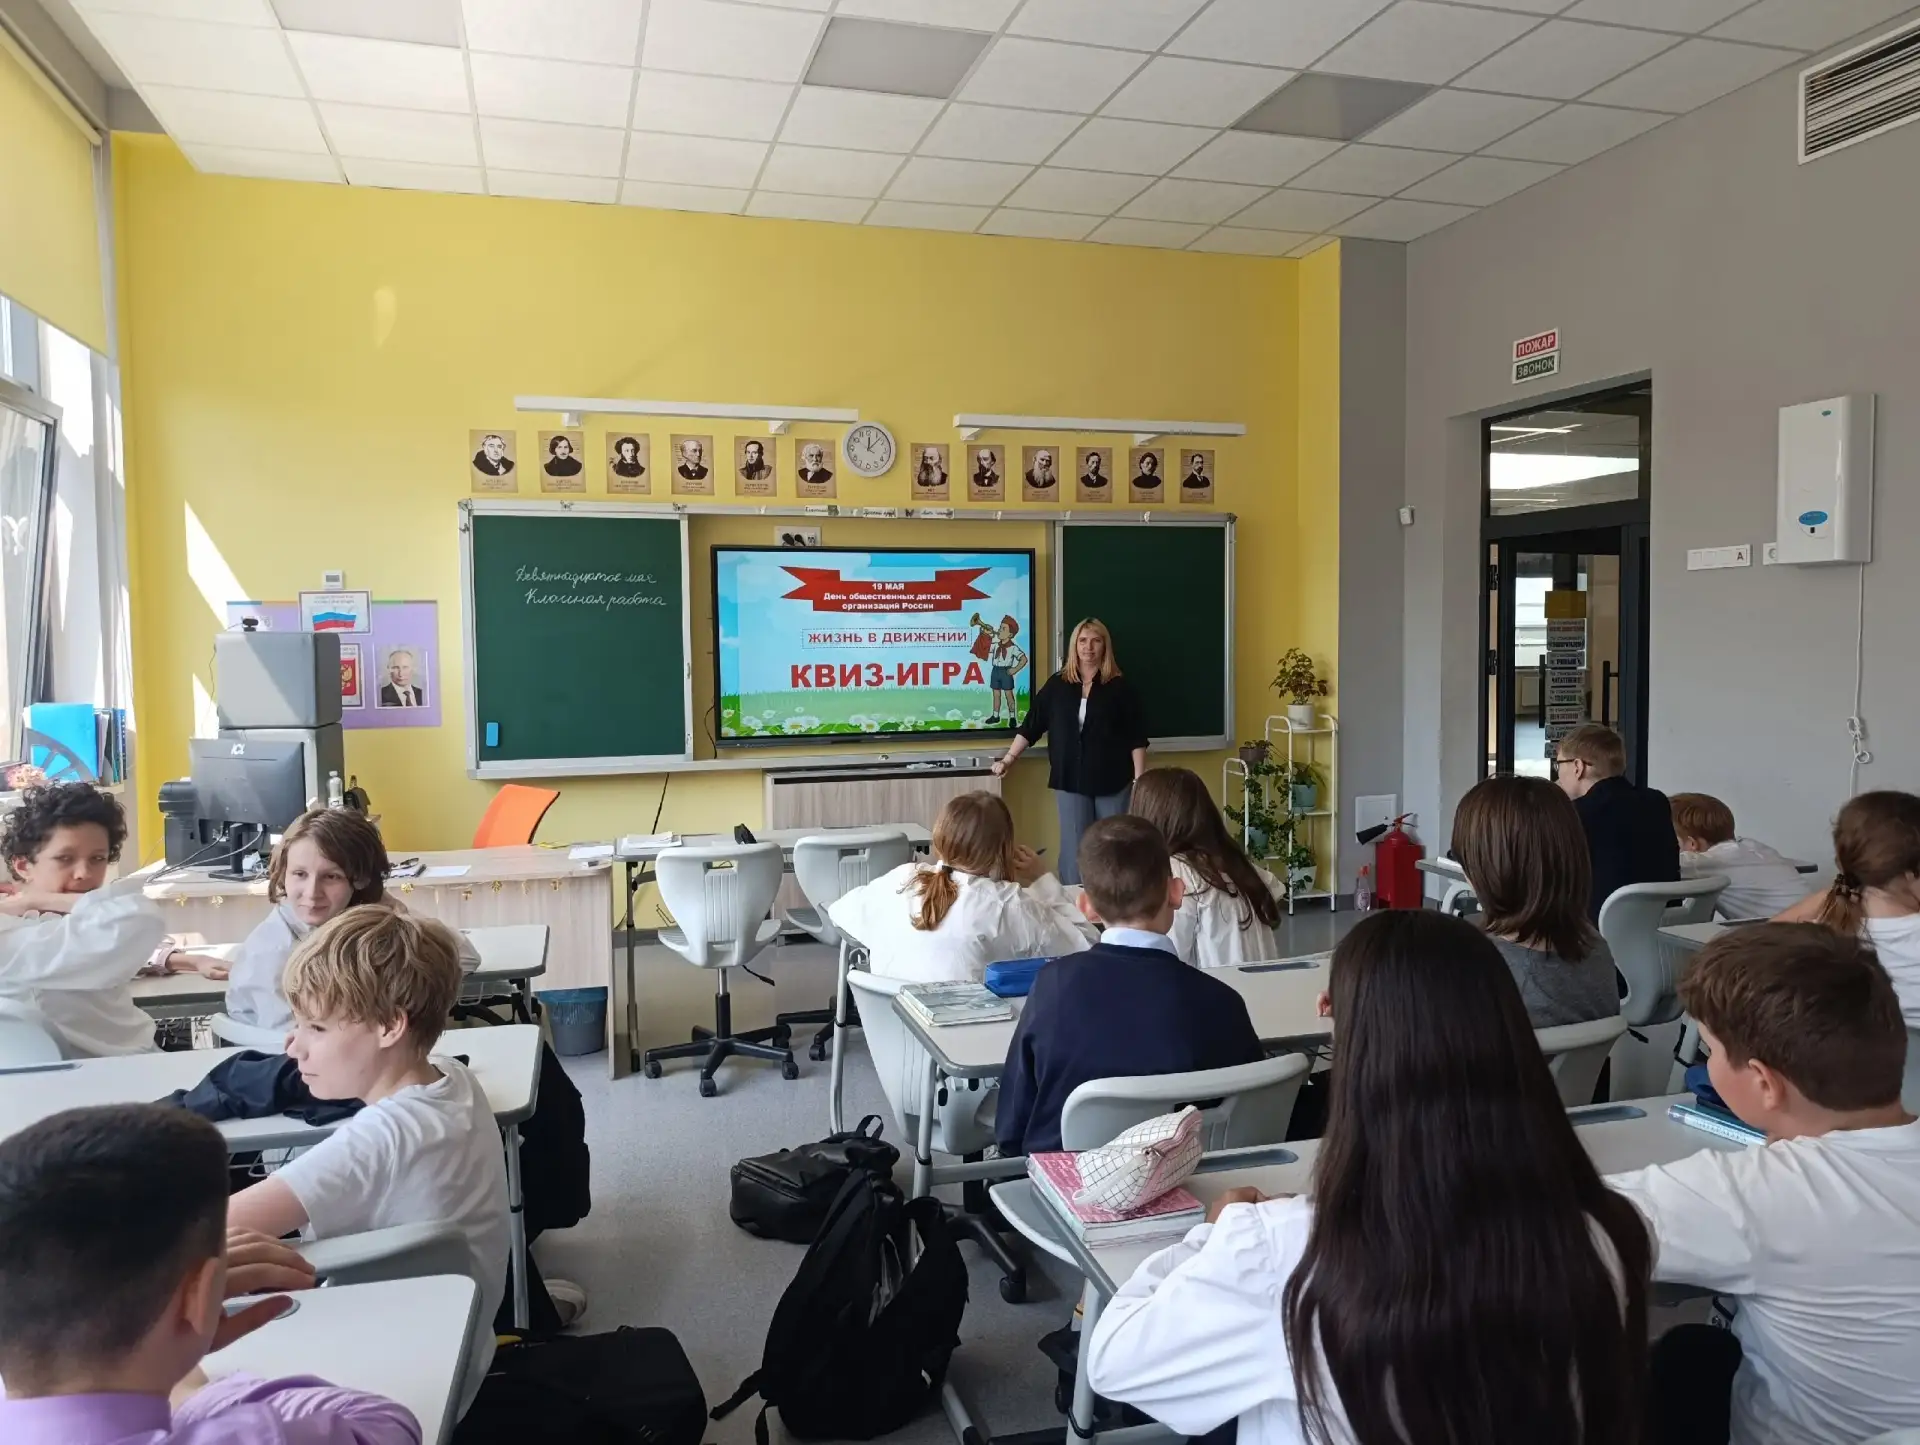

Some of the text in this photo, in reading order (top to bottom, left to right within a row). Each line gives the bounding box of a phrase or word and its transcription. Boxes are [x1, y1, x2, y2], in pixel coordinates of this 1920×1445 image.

[1518, 334, 1555, 356] ПОЖАР
[1517, 360, 1555, 378] ЗВОНОК
[524, 588, 667, 611] Классная работа
[823, 592, 952, 601] День общественных детских
[842, 601, 934, 611] организаций России
[808, 632, 967, 644] ЖИЗНЬ В ДВИЖЕНИИ
[790, 661, 985, 688] КВИЗ-ИГРА
